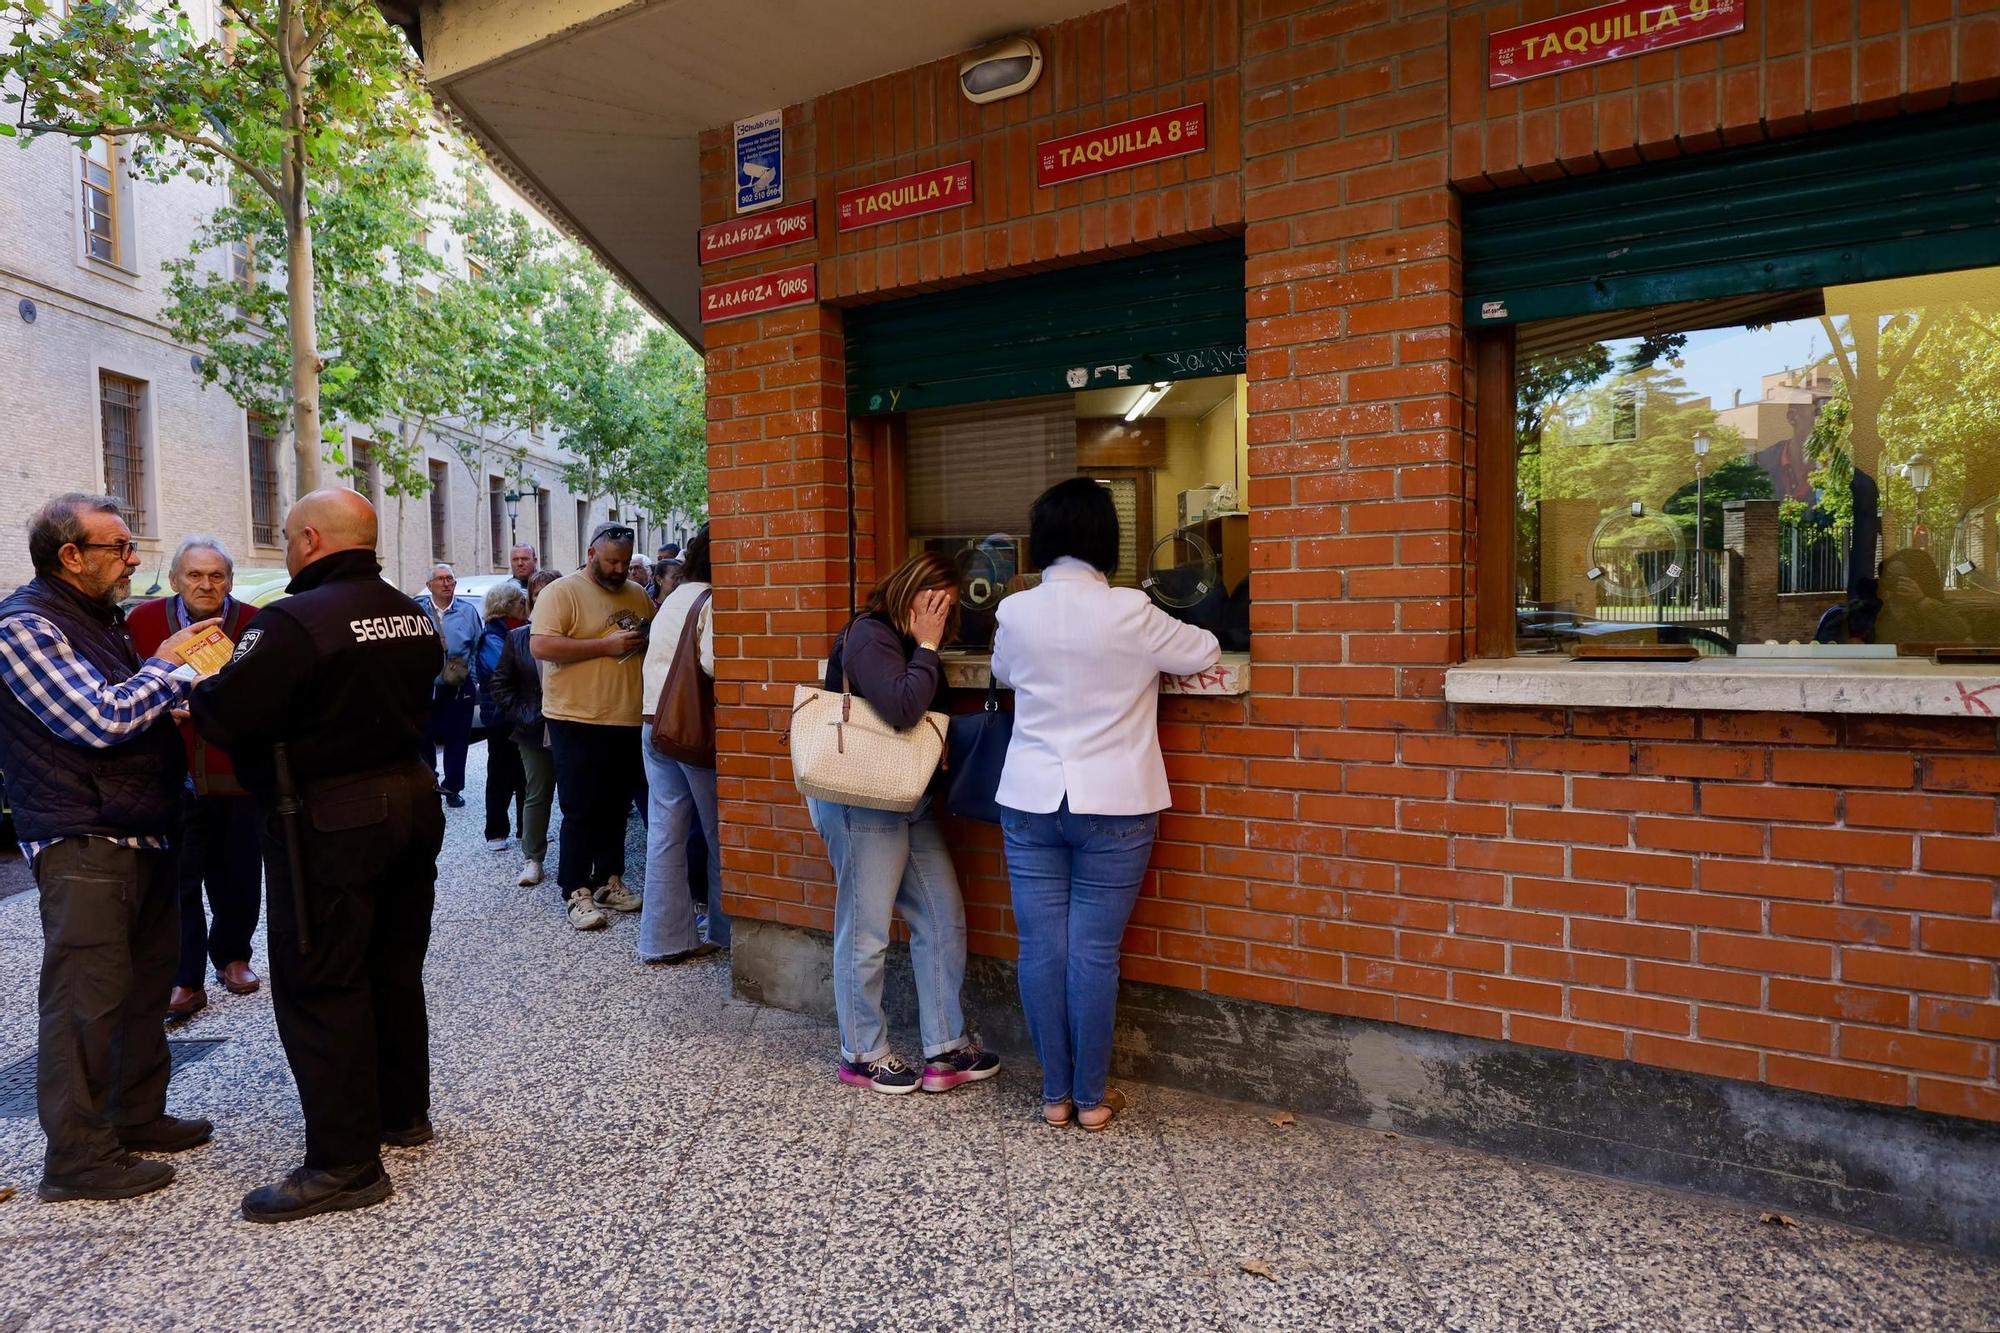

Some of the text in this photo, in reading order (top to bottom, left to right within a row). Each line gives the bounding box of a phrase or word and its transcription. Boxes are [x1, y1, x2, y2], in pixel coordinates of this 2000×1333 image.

[1521, 0, 1709, 61] TAQUILLA 9
[744, 121, 764, 132] Chubb
[1059, 126, 1163, 167] TAQUILLA
[1167, 120, 1182, 142] 8
[741, 194, 753, 204] 902
[855, 180, 940, 215] TAQUILLA
[943, 175, 953, 195] 7
[707, 216, 807, 250] ZARAGOZA TOROS
[707, 278, 808, 310] ZARAGOZA TOROS
[350, 615, 434, 642] SEGURIDAD
